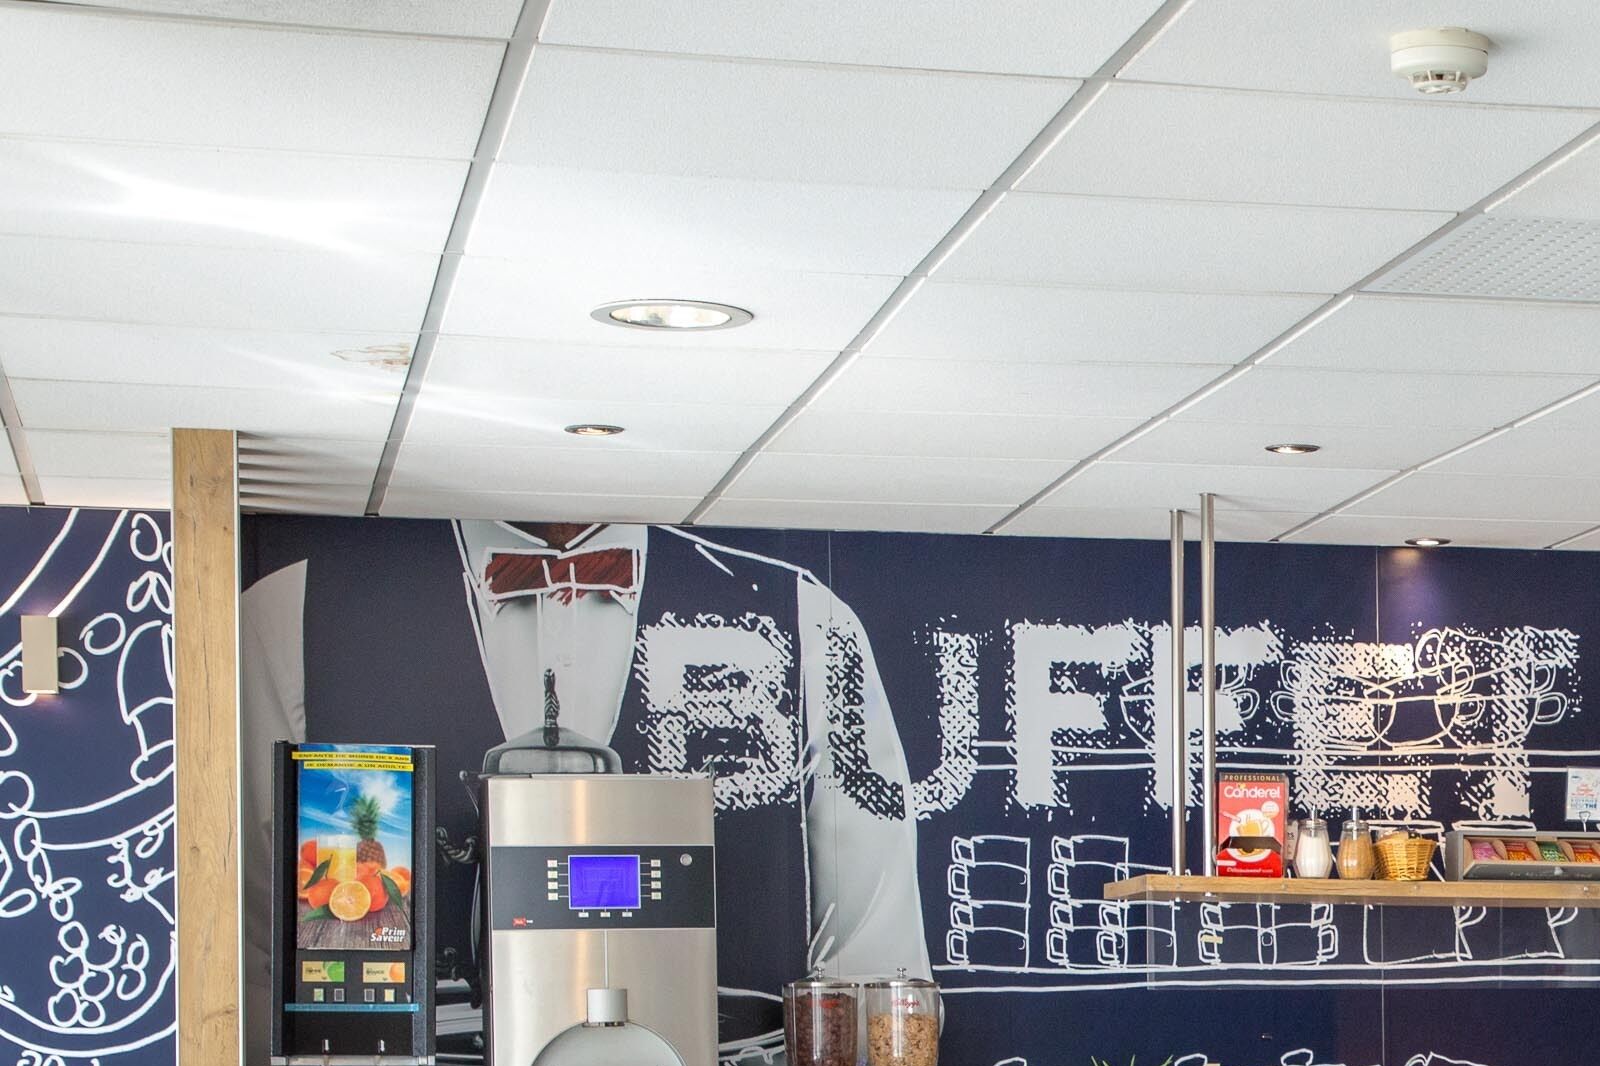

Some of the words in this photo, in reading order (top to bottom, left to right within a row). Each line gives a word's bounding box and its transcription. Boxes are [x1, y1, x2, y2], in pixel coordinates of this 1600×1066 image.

[632, 614, 1580, 820] BUFFET
[1223, 785, 1282, 799] Canderel
[381, 926, 406, 936] Prim
[370, 933, 405, 943] Saveur
